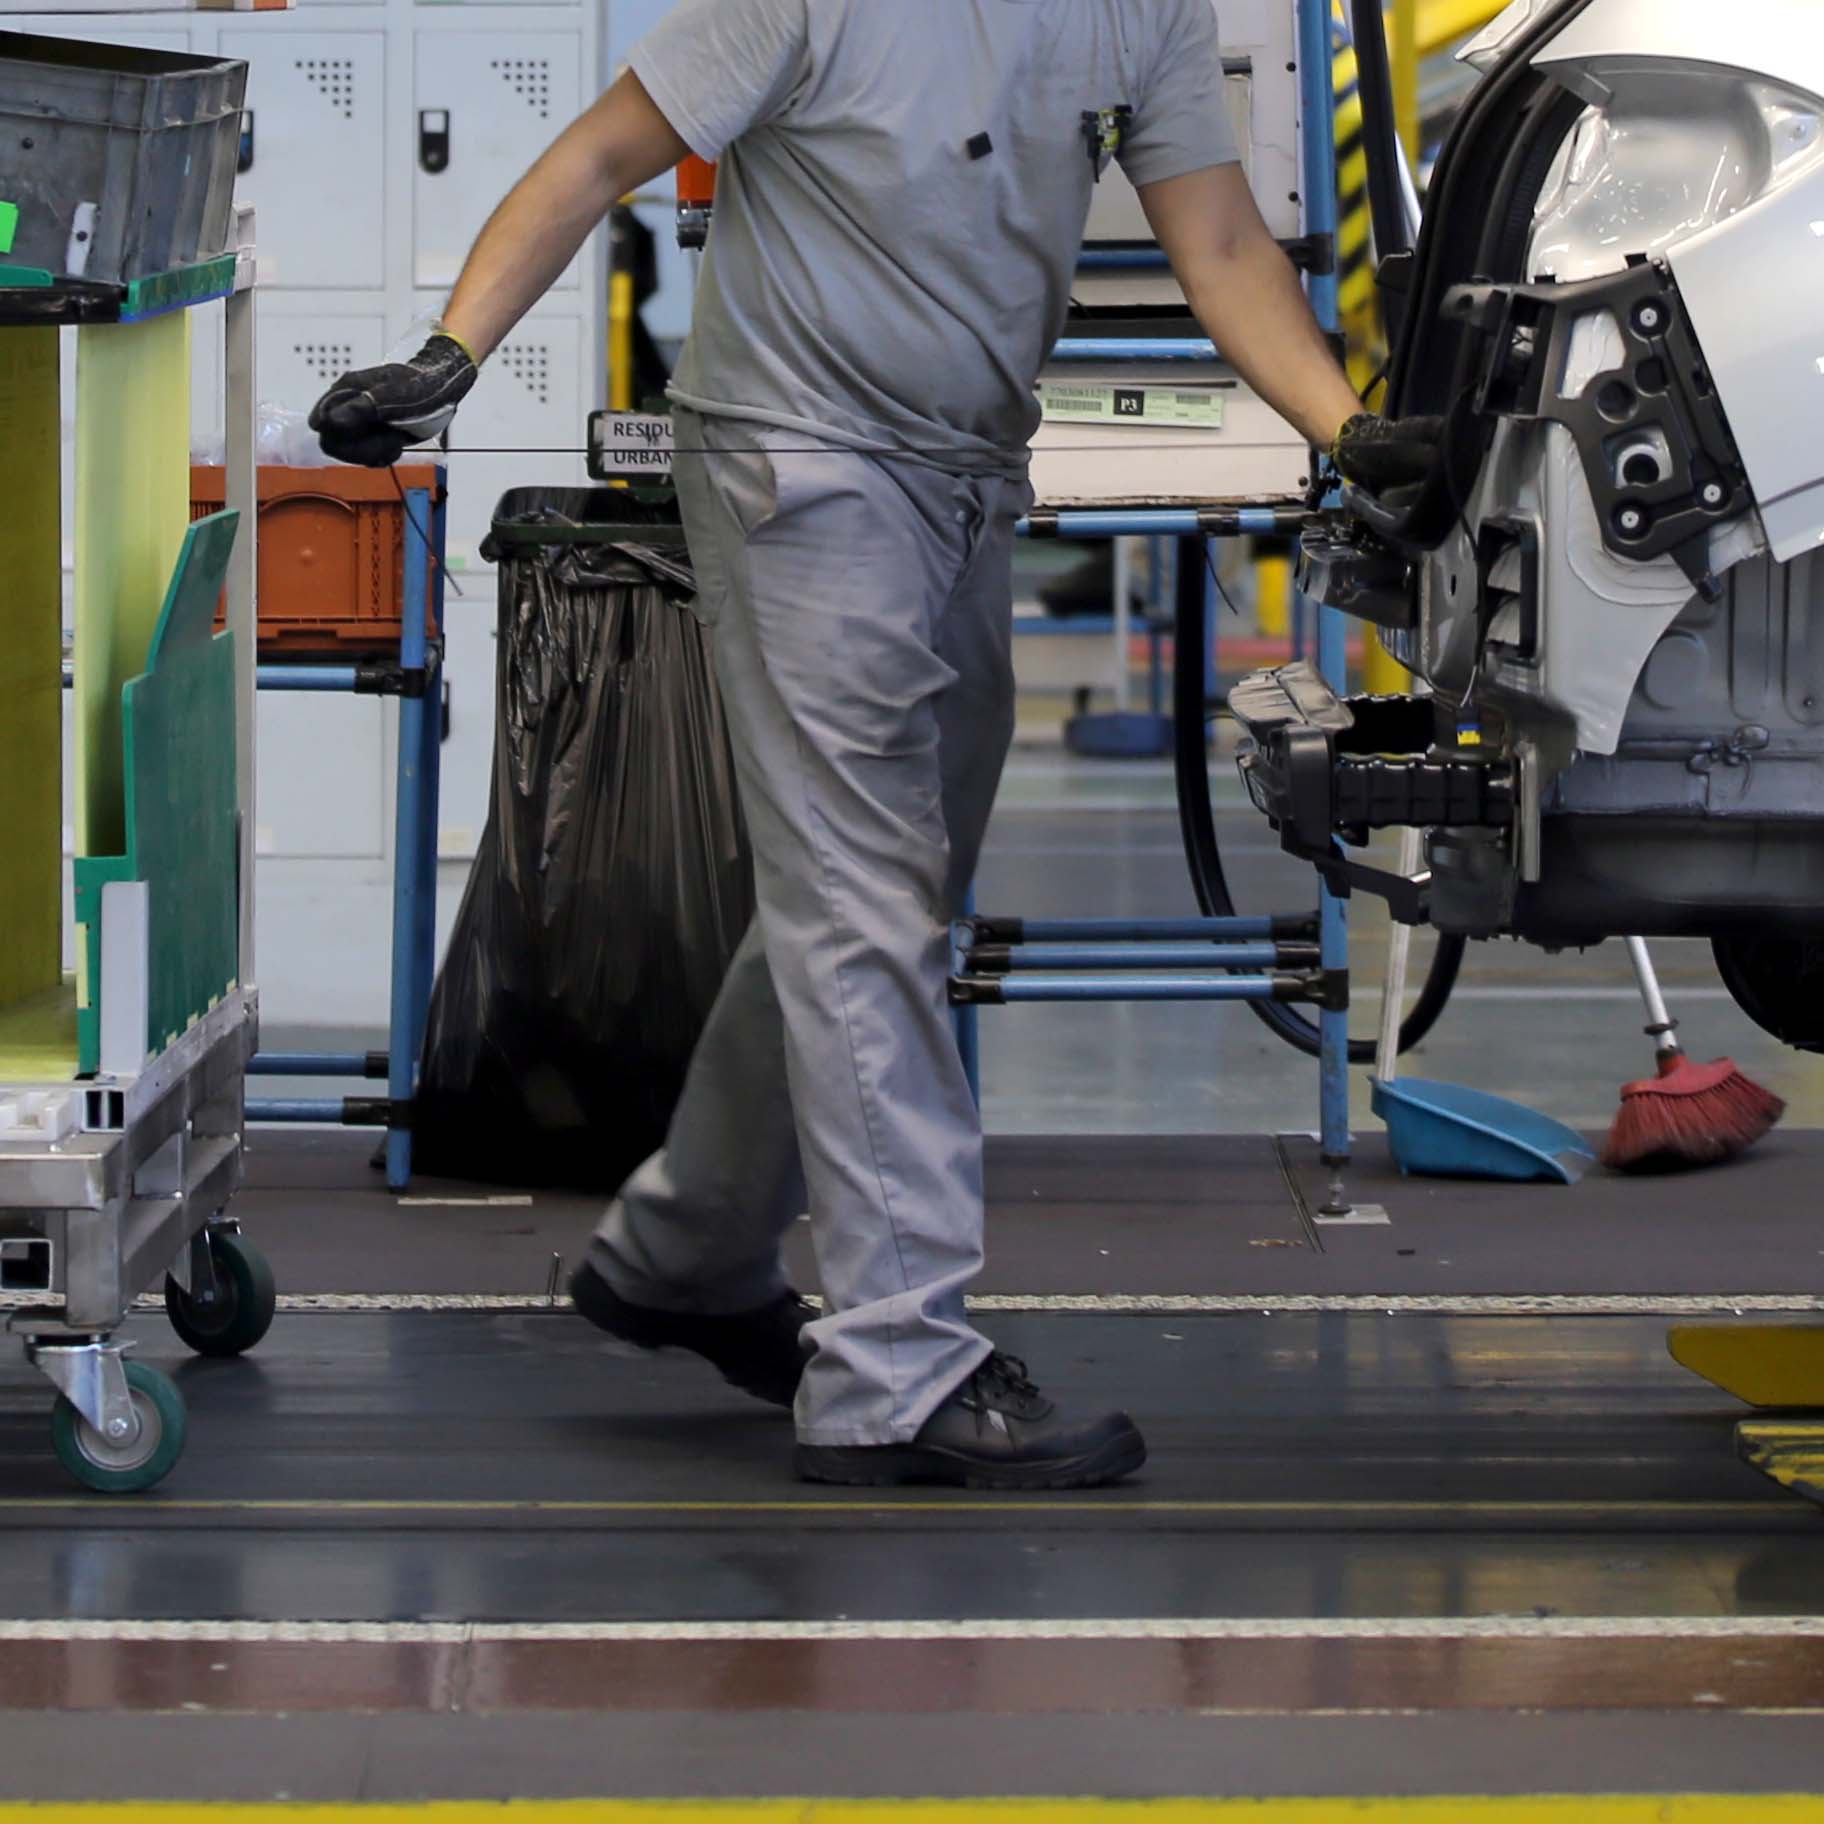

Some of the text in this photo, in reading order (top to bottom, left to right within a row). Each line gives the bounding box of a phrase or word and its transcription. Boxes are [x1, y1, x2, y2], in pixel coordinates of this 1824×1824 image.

[1120, 397, 1138, 412] P3
[613, 422, 673, 438] RESIDU
[613, 451, 673, 465] URBAN
